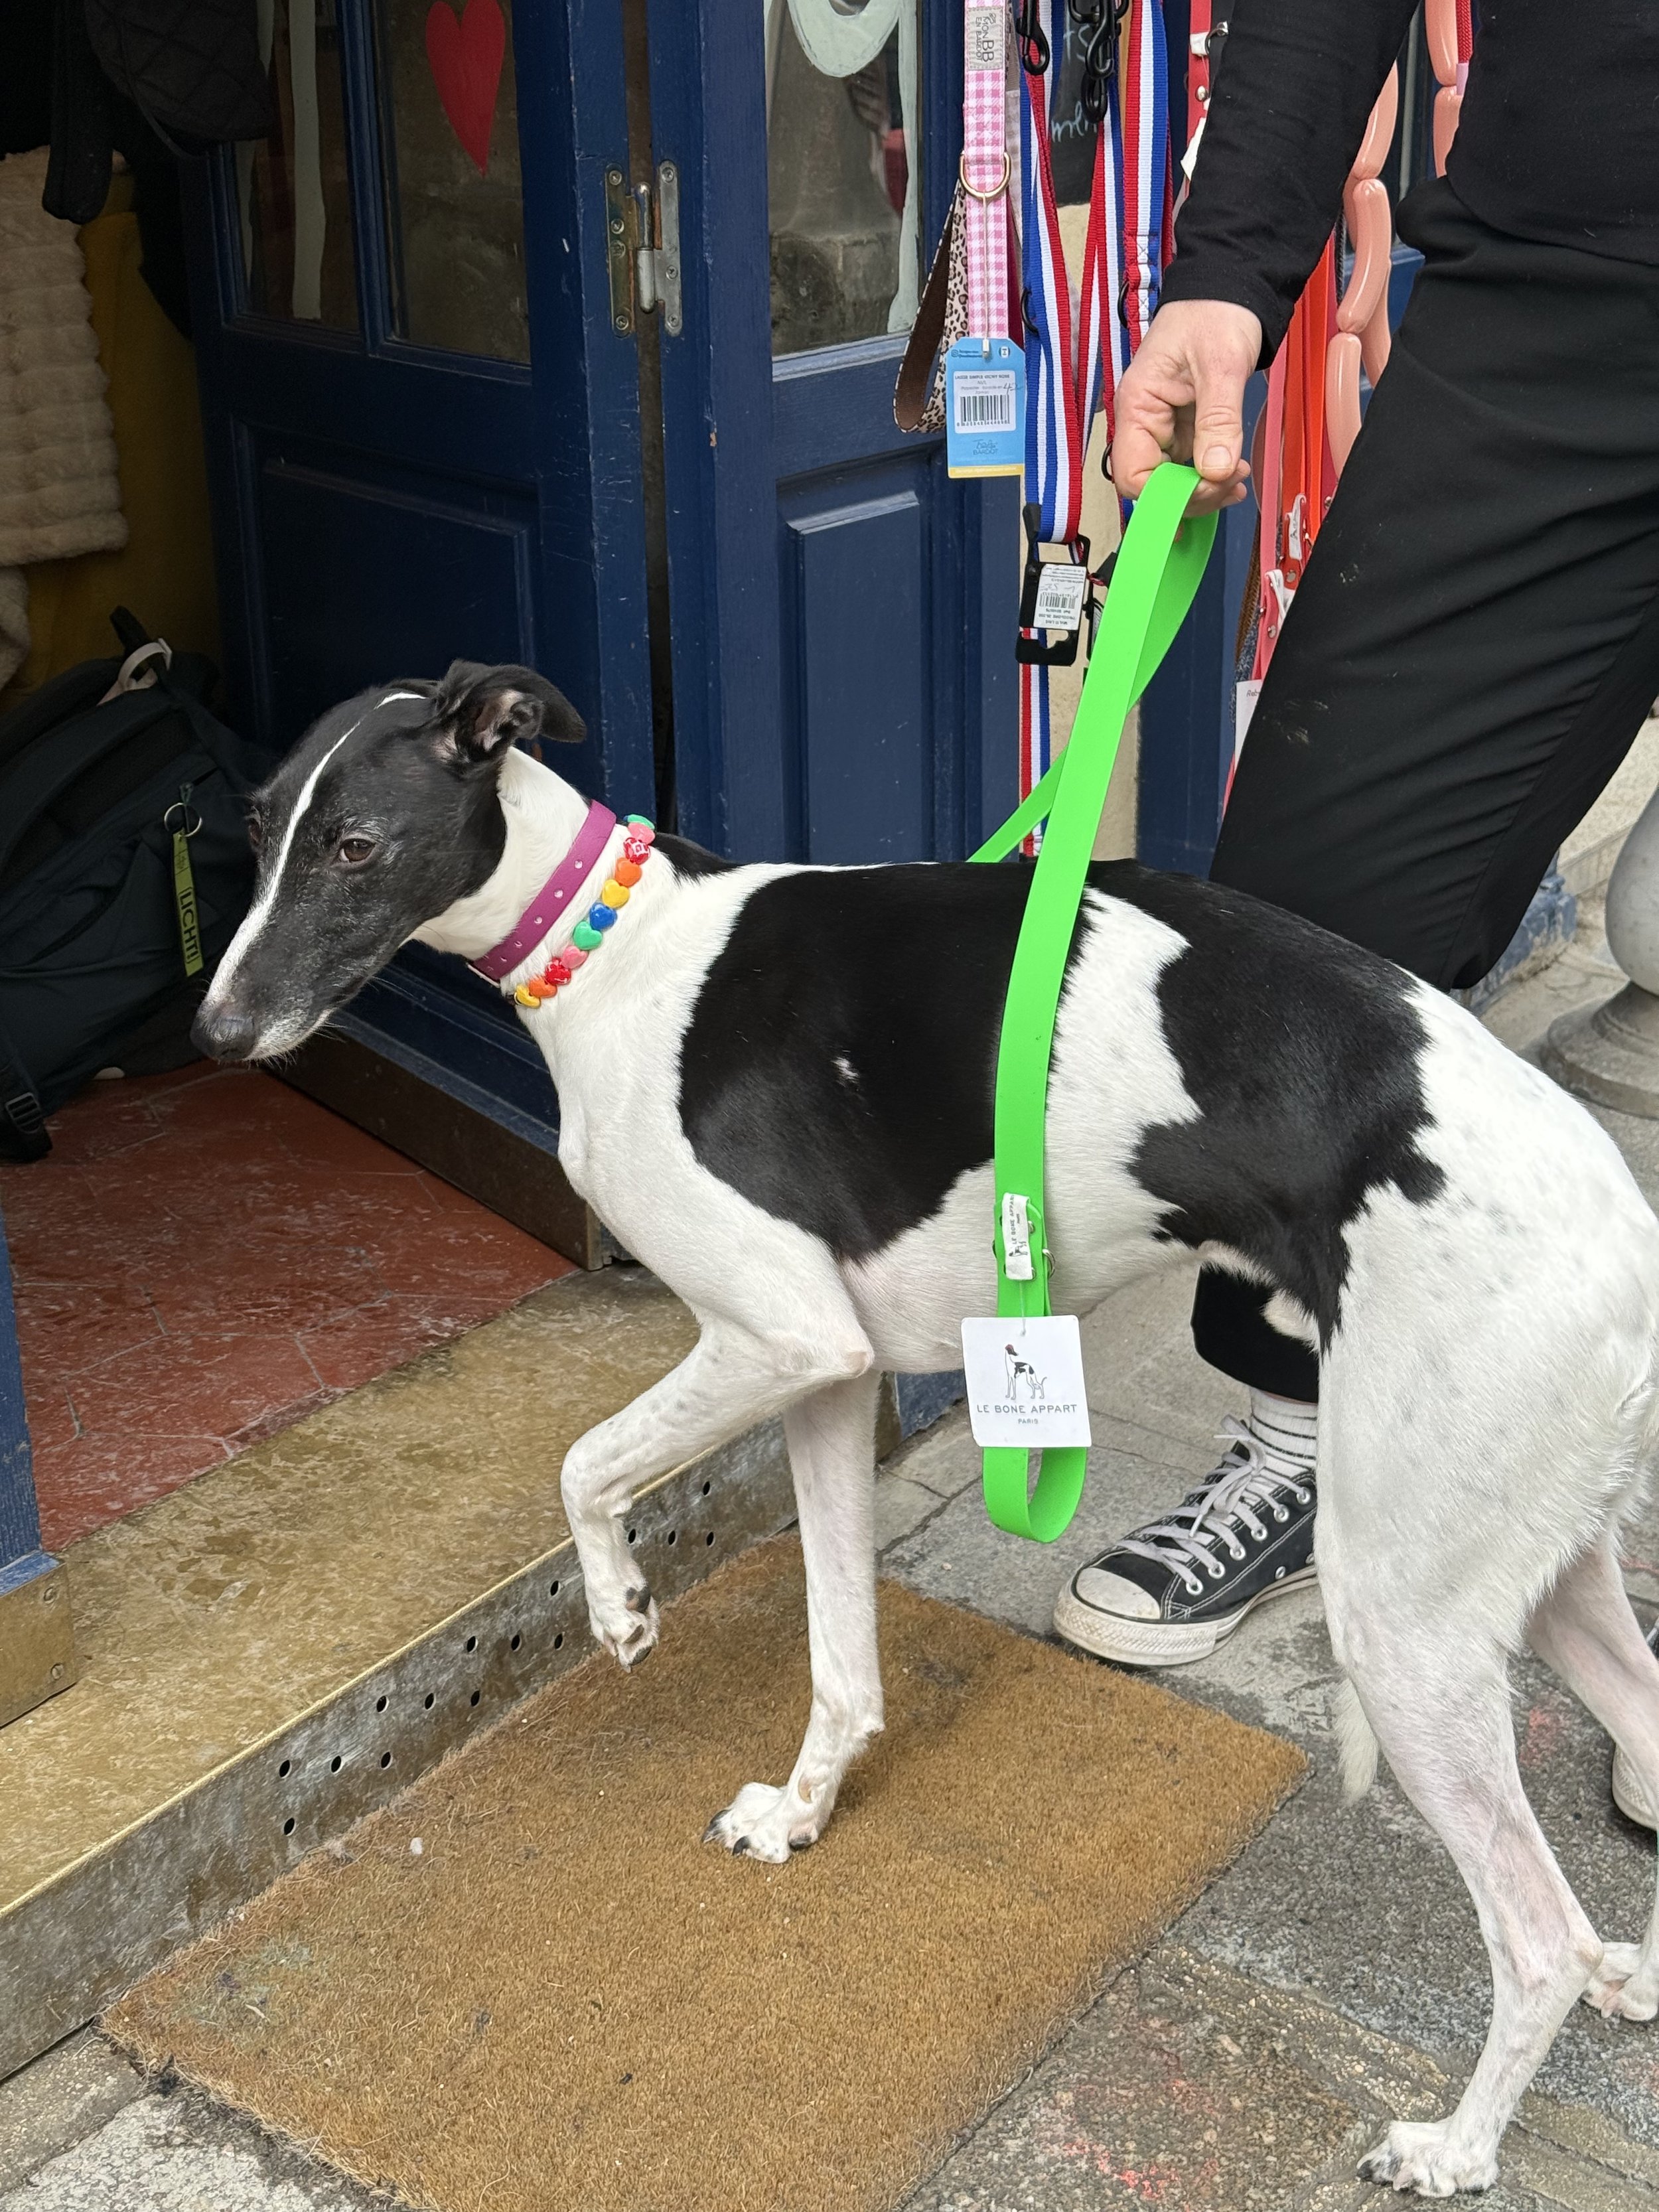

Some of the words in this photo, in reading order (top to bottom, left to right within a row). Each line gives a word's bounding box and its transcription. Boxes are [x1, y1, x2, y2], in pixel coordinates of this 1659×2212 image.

[975, 17, 981, 27] EN
[982, 40, 994, 62] BB
[977, 1404, 989, 1413] LE
[995, 1405, 1026, 1414] BONE
[1031, 1404, 1078, 1413] APPART
